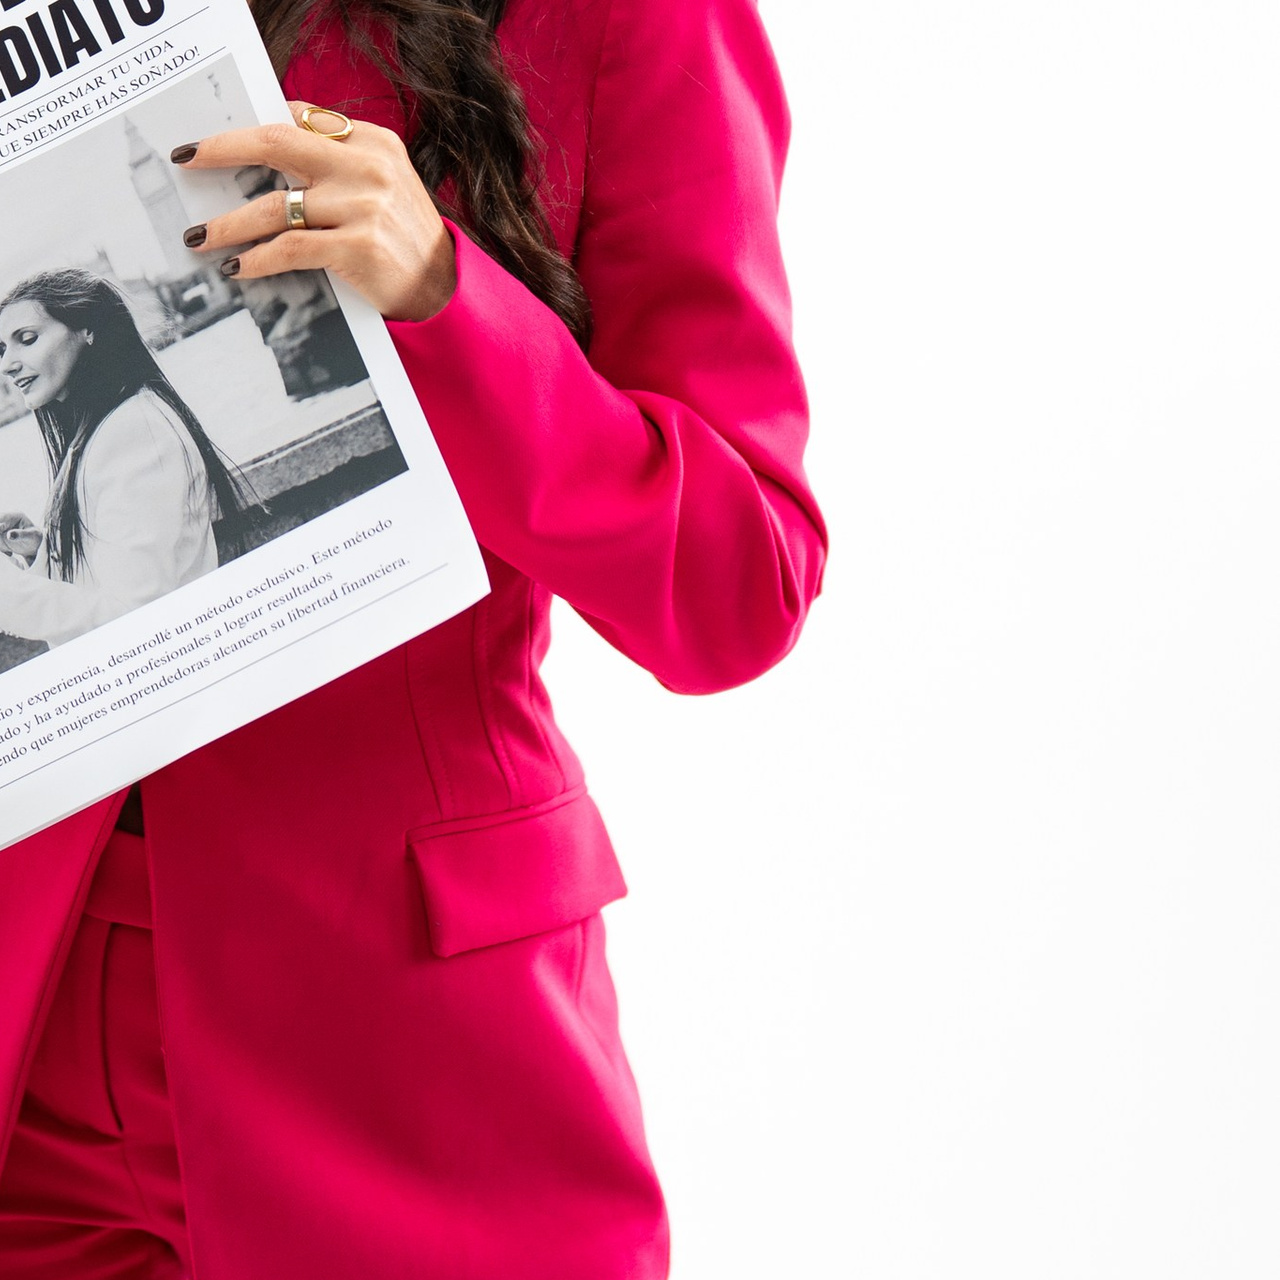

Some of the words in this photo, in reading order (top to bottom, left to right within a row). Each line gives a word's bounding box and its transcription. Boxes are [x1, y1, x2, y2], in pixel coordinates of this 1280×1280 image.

[23, 103, 94, 146] SIEMPRE
[95, 85, 128, 110] HAS
[129, 45, 200, 92] SOÑADO!
[107, 60, 130, 80] TU
[132, 40, 174, 69] VIDA
[16, 701, 23, 715] y
[27, 666, 105, 706] experiencia,
[108, 628, 172, 668] desarrollé
[174, 622, 192, 635] un
[194, 595, 243, 626] método
[246, 564, 309, 599] exclusivo.
[311, 546, 340, 565] Este
[343, 519, 392, 550] método
[23, 720, 31, 734] y
[34, 712, 52, 725] ha
[54, 683, 111, 716] ayudado
[114, 678, 123, 687] a
[126, 634, 212, 685] profesionales
[214, 629, 222, 638] a
[223, 606, 263, 633] lograr
[267, 572, 333, 611] resultados
[30, 733, 54, 752] que
[56, 707, 108, 738] mujeres
[110, 657, 210, 711] emprendedoras
[213, 628, 268, 662] alcancen
[270, 619, 286, 632] su
[287, 589, 339, 623] libertad
[341, 558, 410, 596] financiera.
